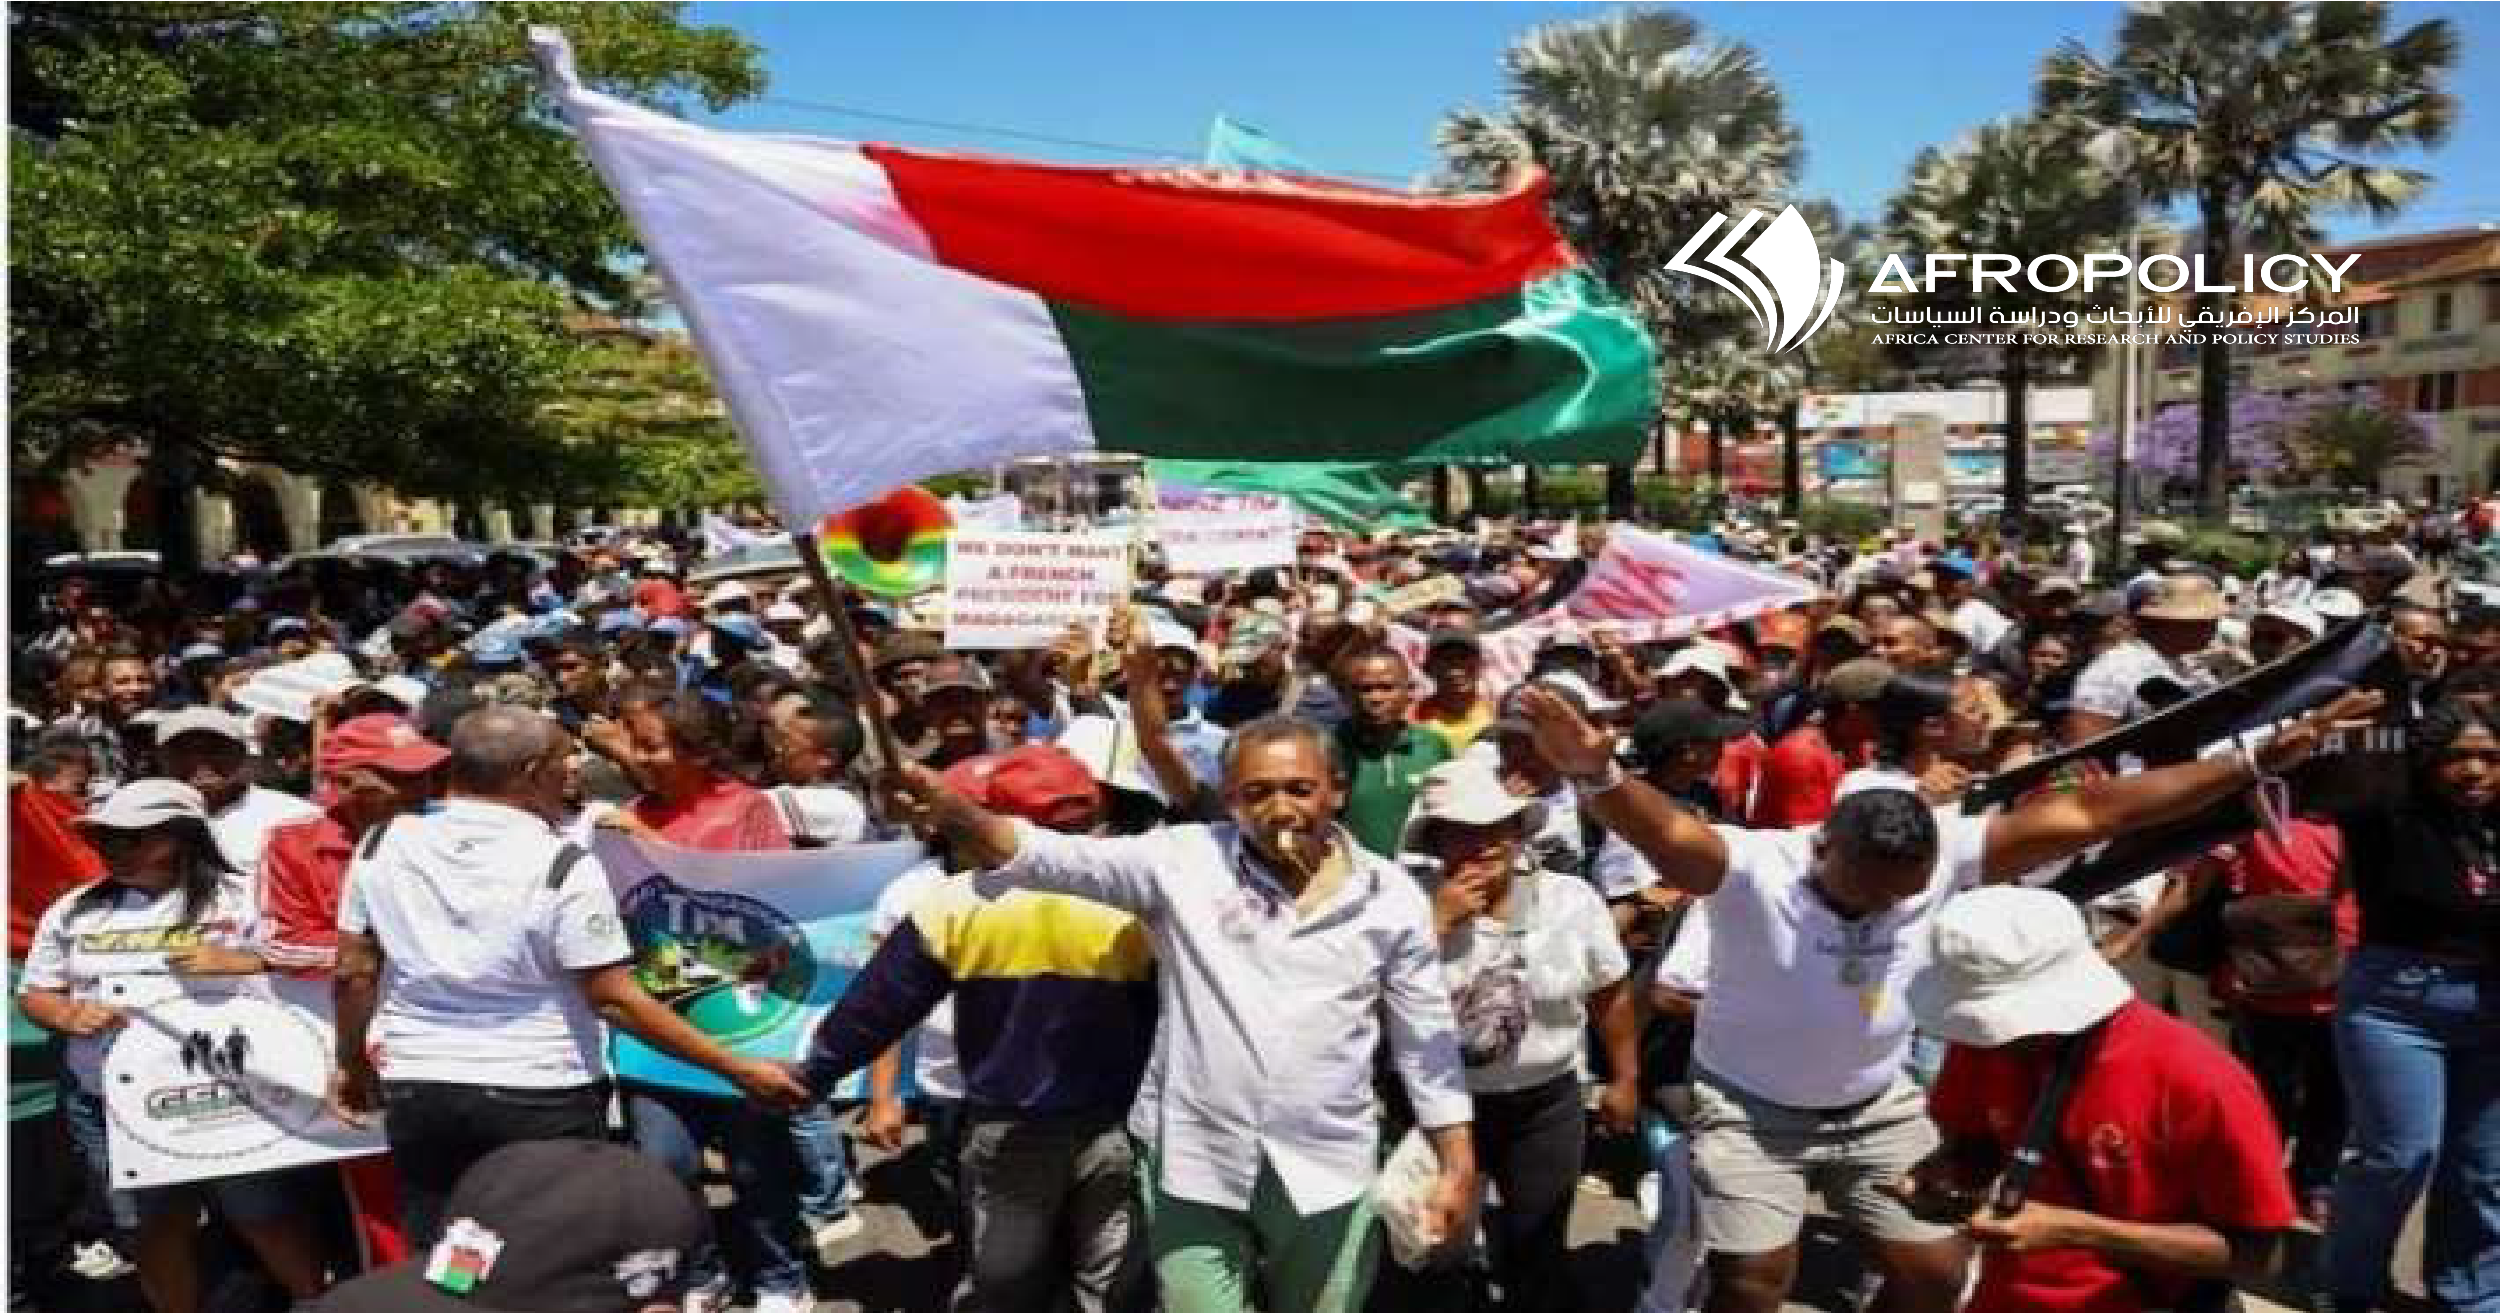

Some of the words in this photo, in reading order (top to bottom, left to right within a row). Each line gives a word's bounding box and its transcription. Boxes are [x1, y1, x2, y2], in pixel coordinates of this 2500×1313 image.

[956, 540, 987, 556] WE
[995, 543, 1061, 557] DON'T
[1010, 565, 1096, 582] FRENCH
[955, 588, 1071, 604] PRESIDENT
